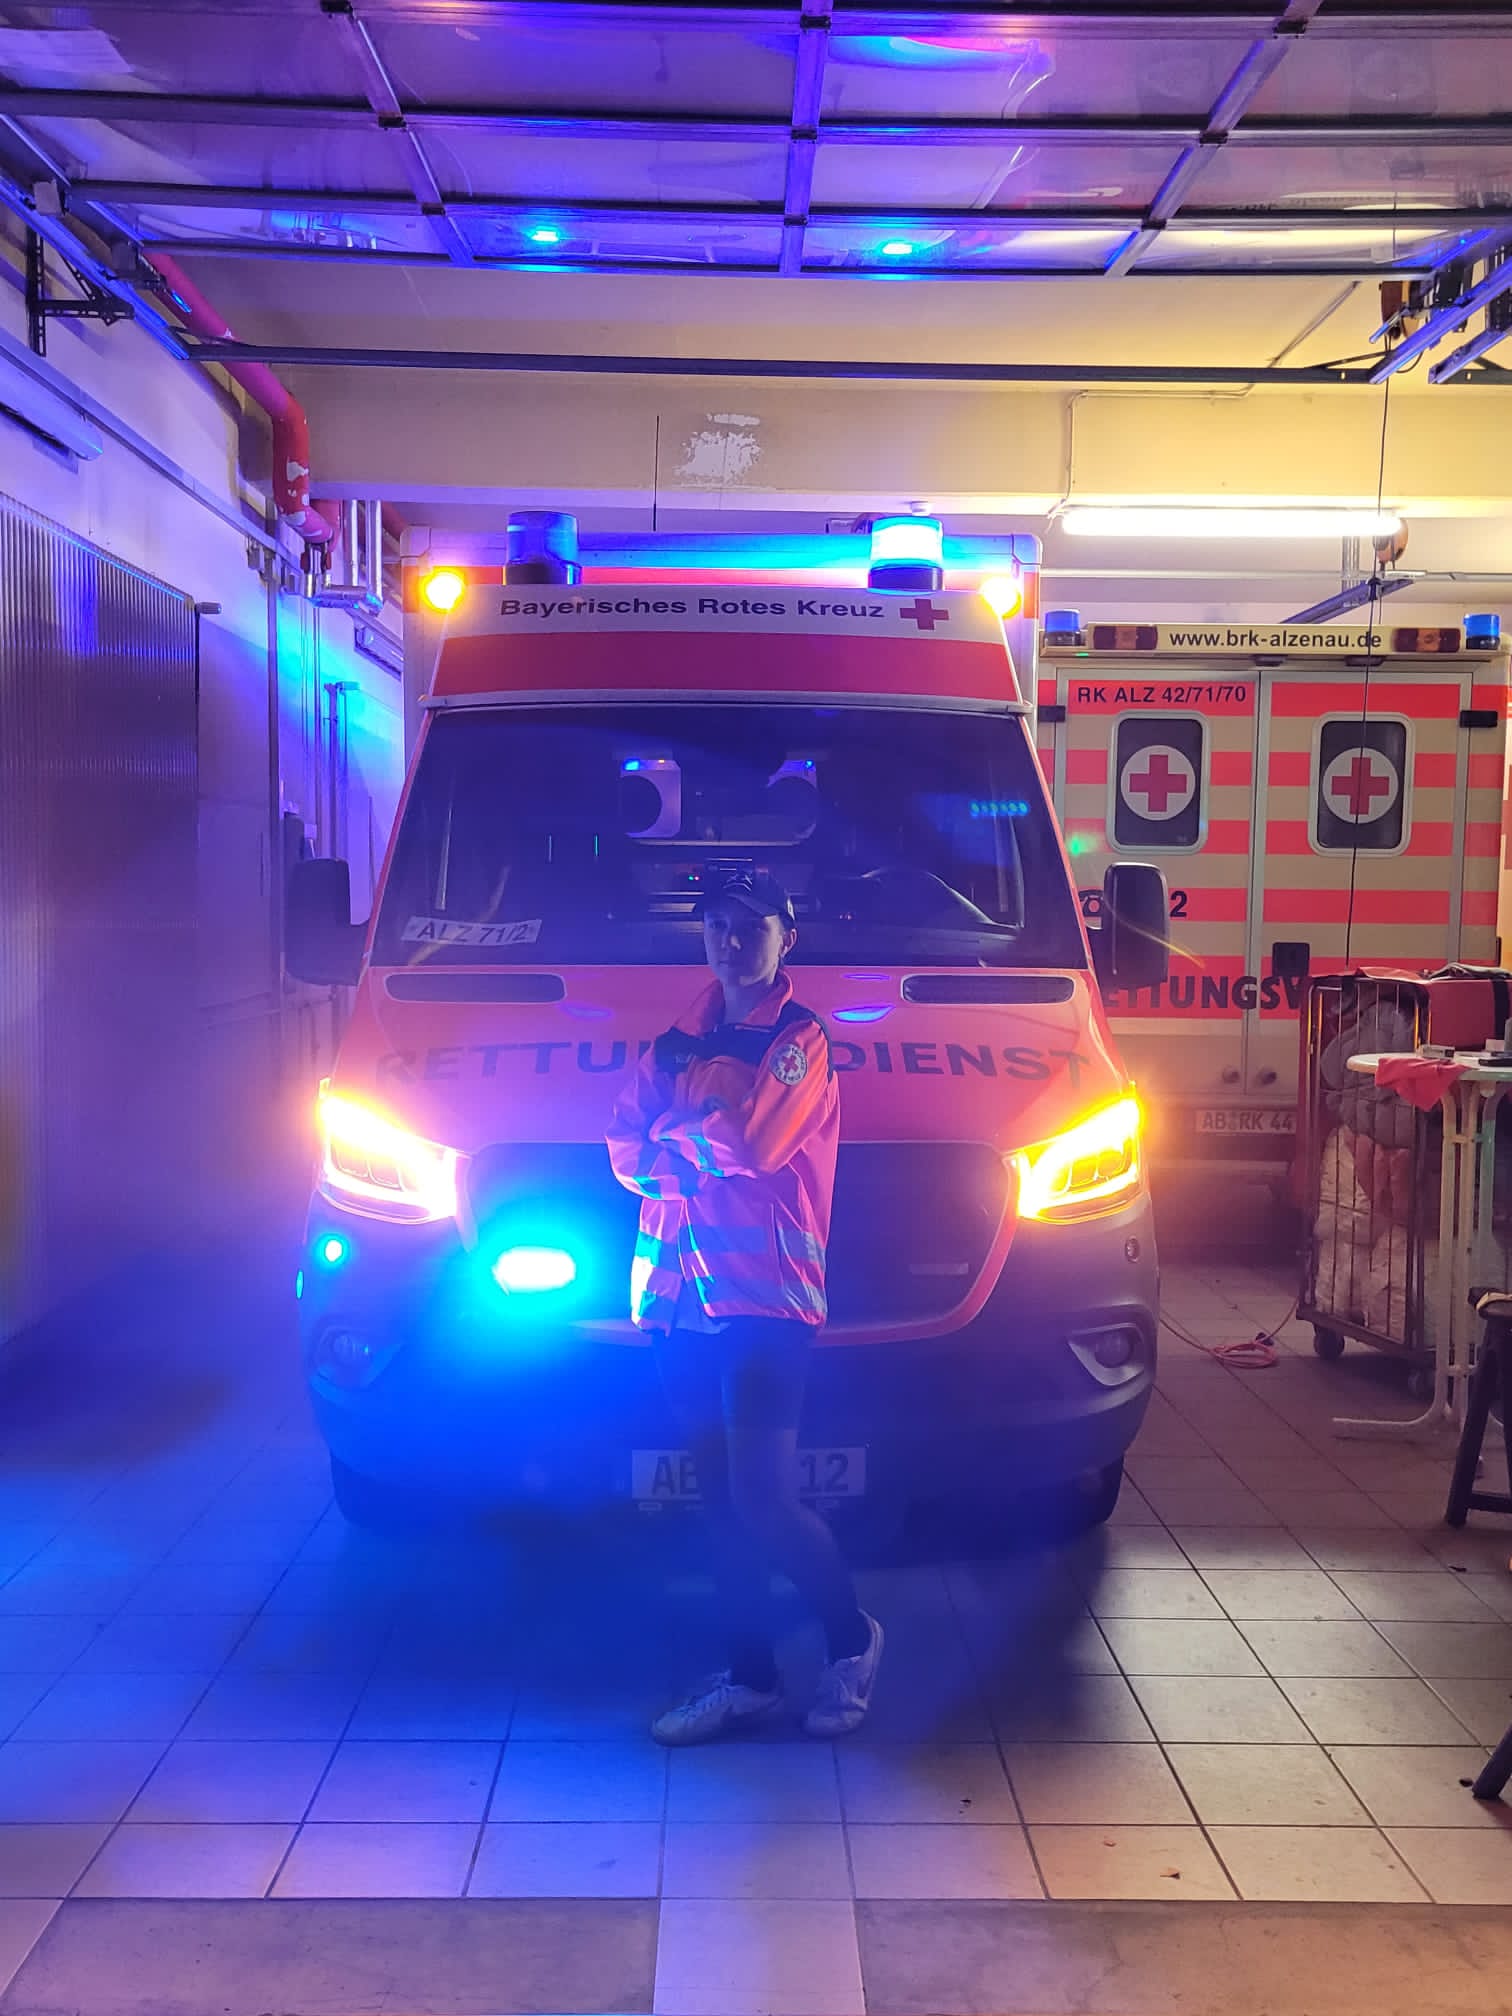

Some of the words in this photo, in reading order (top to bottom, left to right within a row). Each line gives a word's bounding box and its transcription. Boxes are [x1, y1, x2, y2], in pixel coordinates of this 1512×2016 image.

[500, 598, 687, 618] Bayerisches
[698, 598, 786, 615] Rotes
[798, 599, 885, 618] Kreuz
[1169, 629, 1382, 648] www.brk-alzenau.de
[1078, 687, 1106, 703] RK
[1115, 687, 1155, 703] ALZ
[1162, 686, 1247, 703] 42/71/70
[1169, 890, 1188, 918] 2
